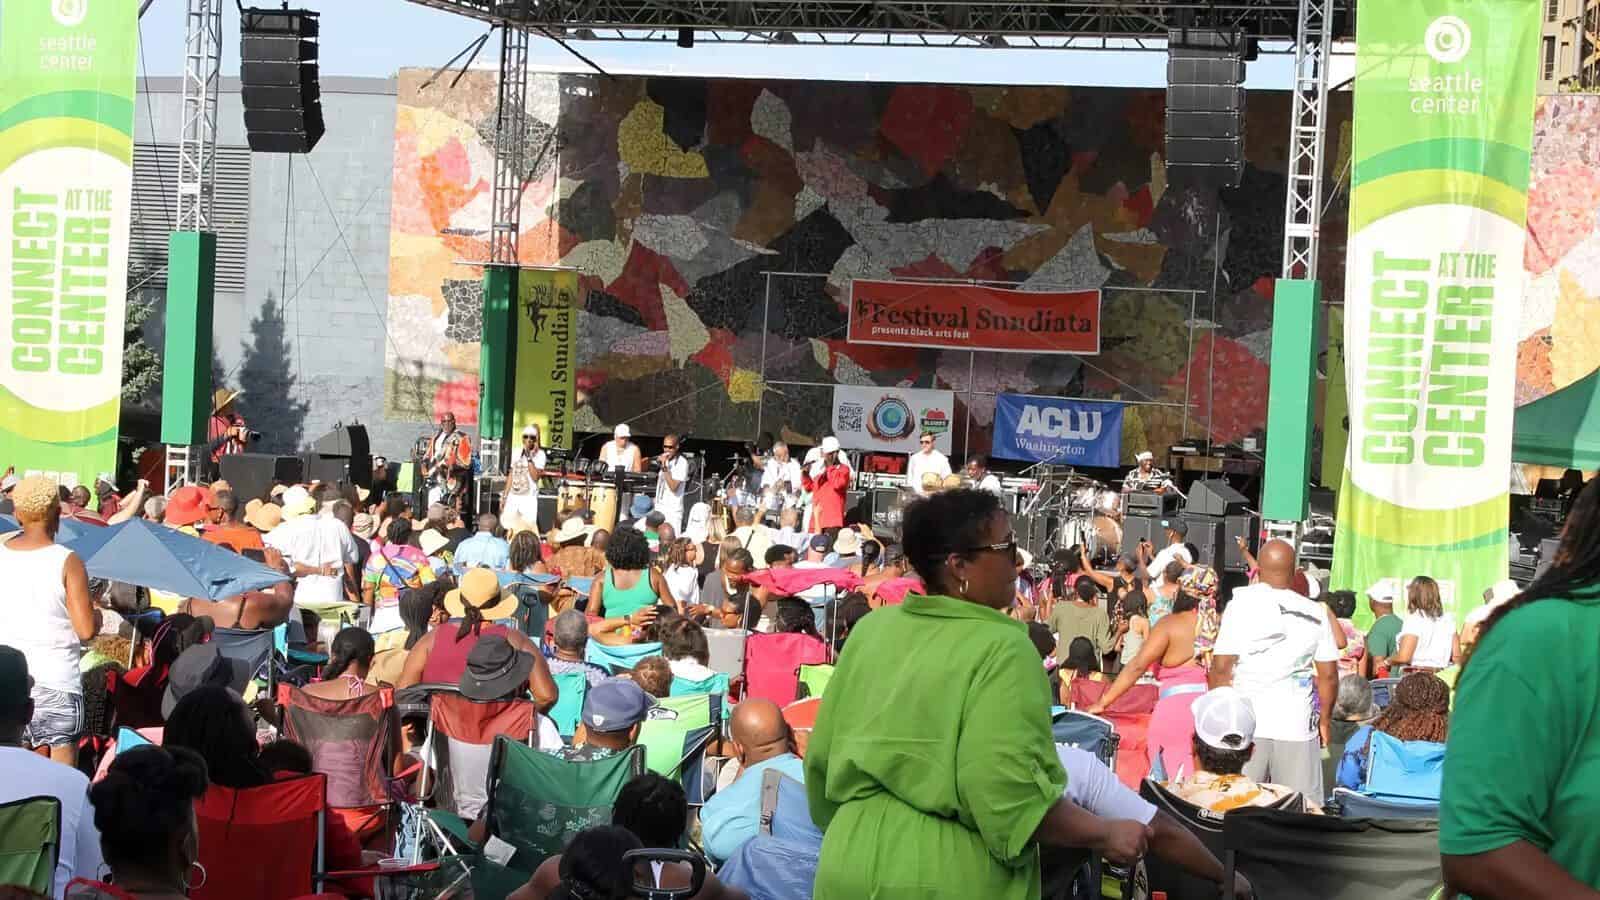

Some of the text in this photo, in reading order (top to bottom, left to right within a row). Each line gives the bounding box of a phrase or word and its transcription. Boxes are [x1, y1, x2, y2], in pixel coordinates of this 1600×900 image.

[40, 33, 96, 50] seattle
[41, 54, 92, 71] center
[1408, 72, 1482, 92] seattle
[1410, 95, 1480, 113] center
[65, 189, 112, 211] AT THE
[1438, 252, 1496, 279] AT THE
[11, 186, 58, 373] CONNECT
[57, 217, 111, 375] CENTER
[871, 303, 969, 327] Festival
[551, 292, 569, 382] Sundiata
[872, 326, 909, 336] presents
[1361, 251, 1431, 464] CONNECT
[1423, 284, 1494, 467] CENTER
[1015, 405, 1102, 440] ACLU
[1015, 437, 1086, 456] Washington
